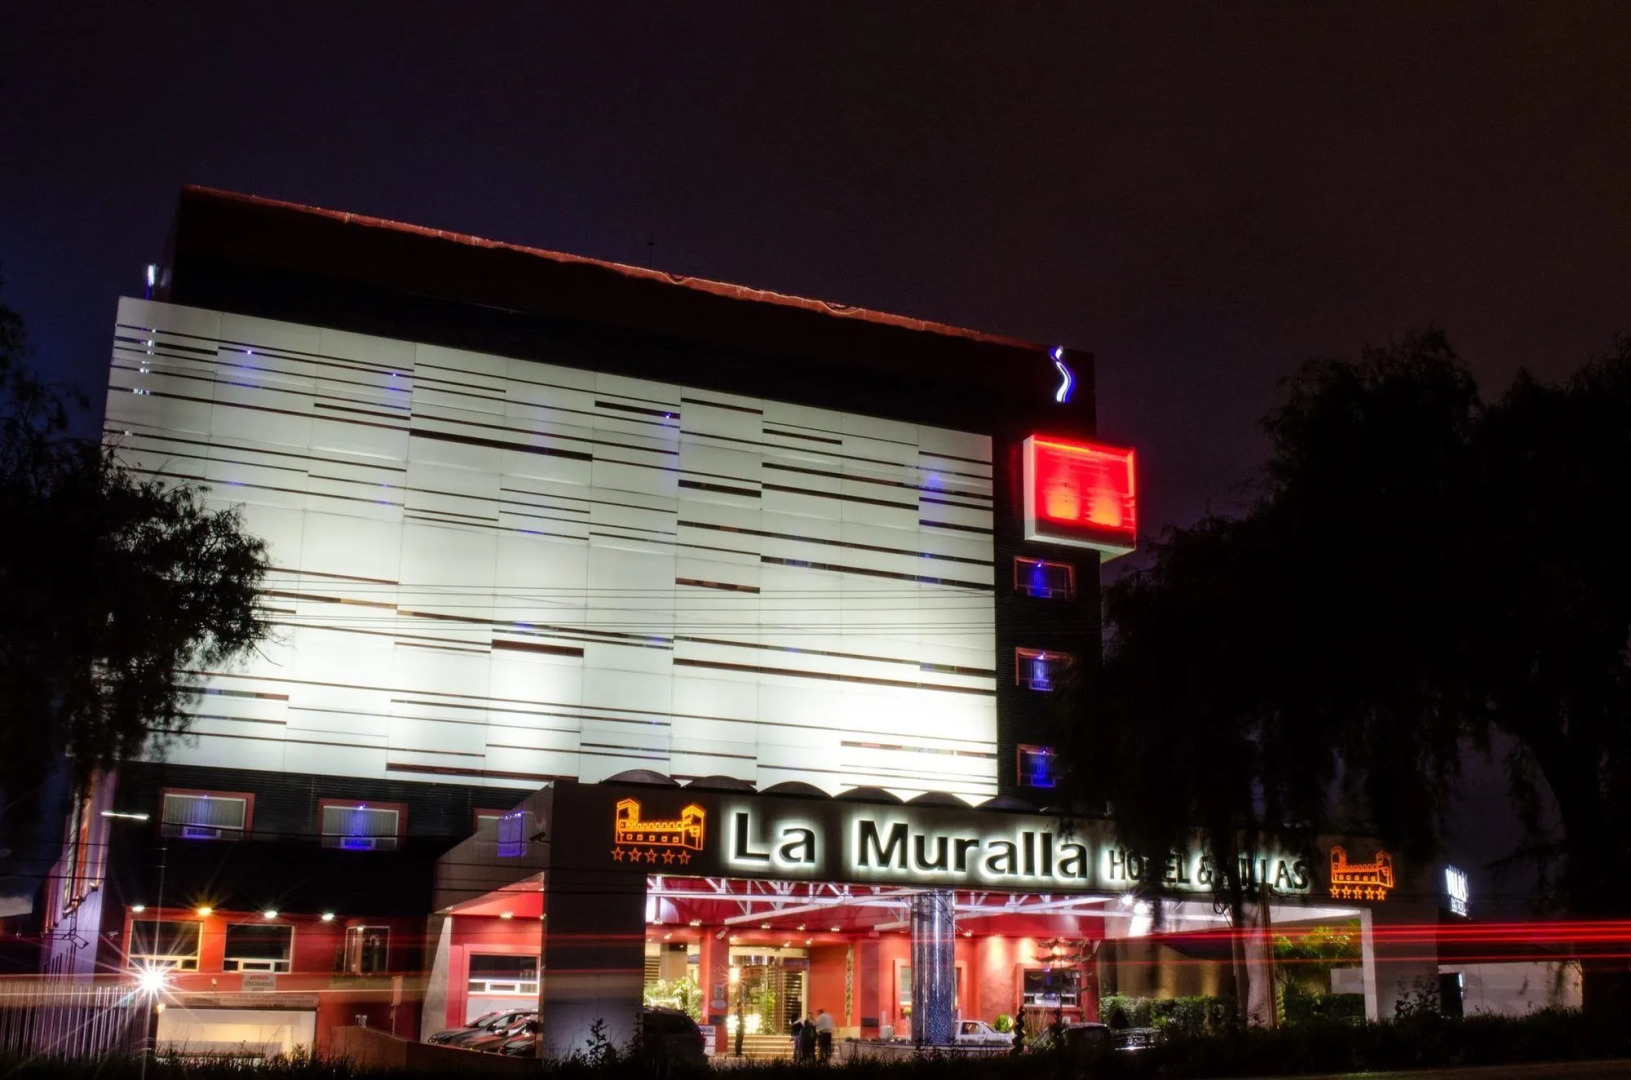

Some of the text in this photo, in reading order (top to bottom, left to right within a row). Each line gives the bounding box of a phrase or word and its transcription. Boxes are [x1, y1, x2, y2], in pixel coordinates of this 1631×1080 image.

[734, 812, 816, 863] La
[857, 820, 1088, 879] Muralla
[1108, 849, 1191, 884] HOEL
